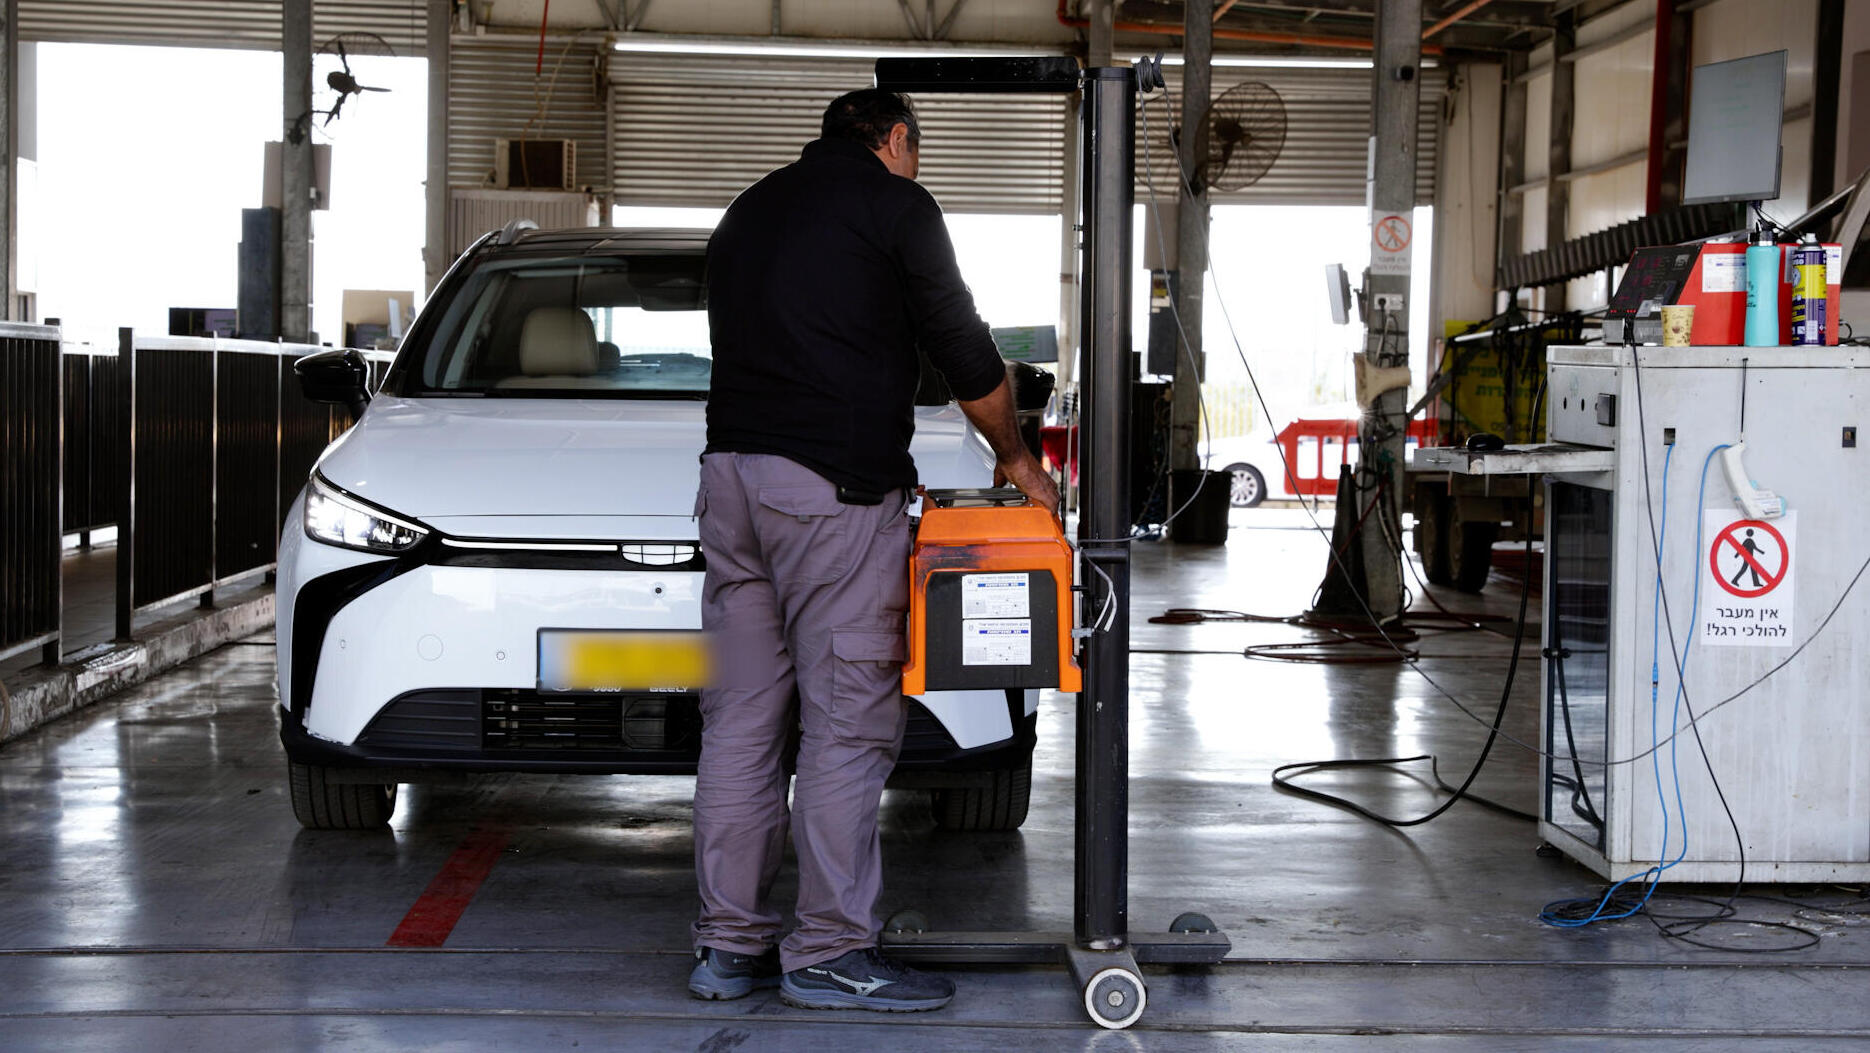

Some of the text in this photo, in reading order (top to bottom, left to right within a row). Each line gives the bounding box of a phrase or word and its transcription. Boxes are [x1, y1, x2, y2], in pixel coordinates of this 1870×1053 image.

[1716, 608, 1779, 621] אין מעבר
[1706, 623, 1787, 637] להולכי רגל!
